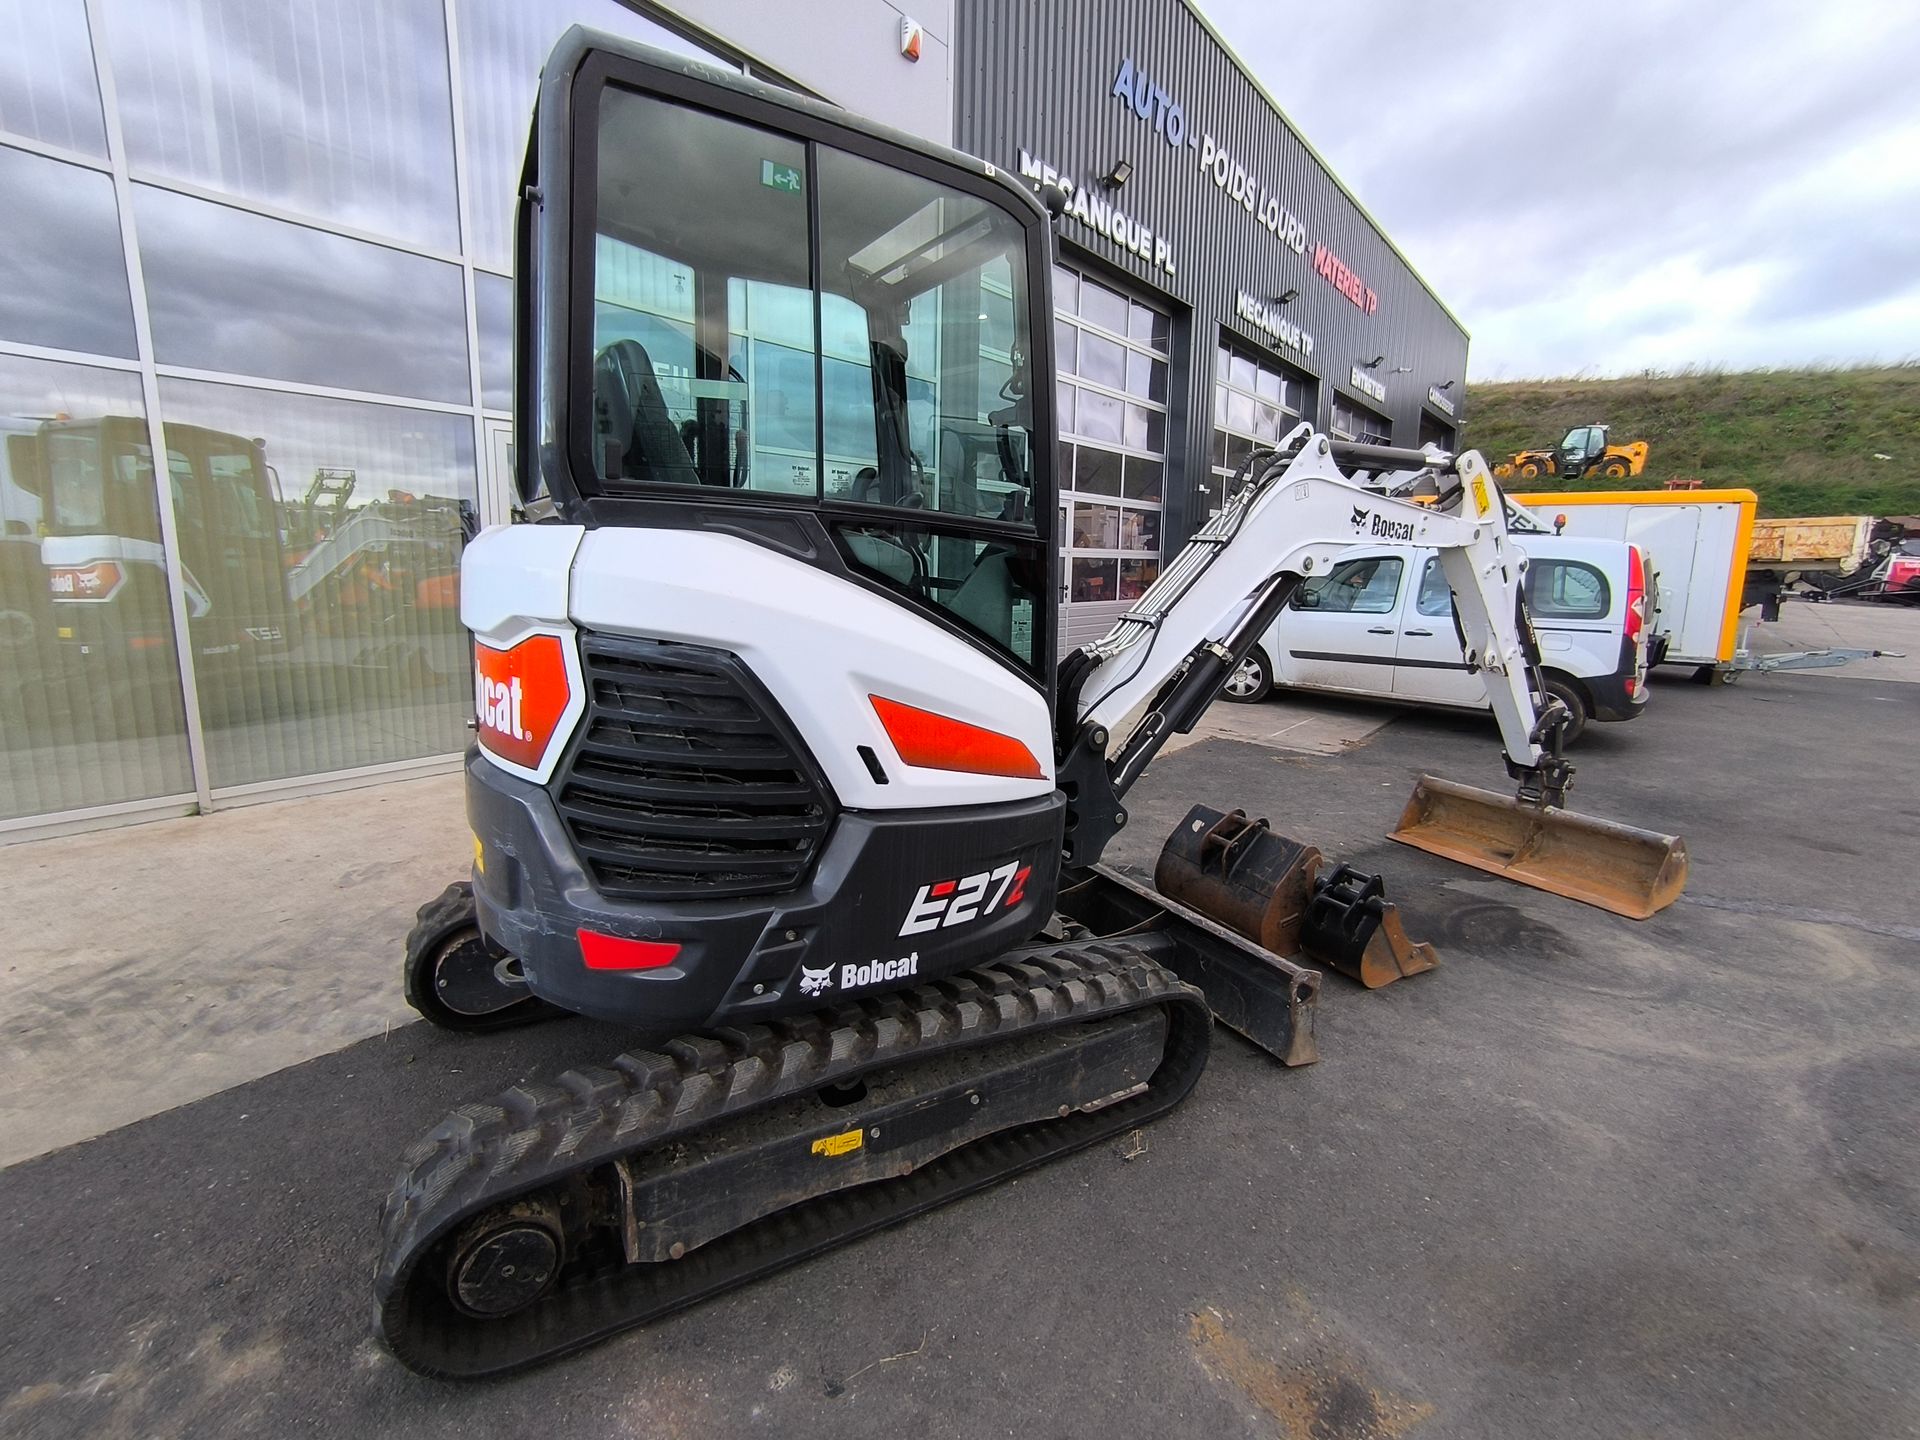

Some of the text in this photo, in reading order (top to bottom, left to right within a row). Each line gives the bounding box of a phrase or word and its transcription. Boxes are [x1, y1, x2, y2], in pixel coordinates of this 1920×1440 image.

[1112, 57, 1185, 147] AUTO
[1200, 133, 1256, 213] POIDS
[1256, 187, 1306, 255] LOURD
[1313, 240, 1362, 308] MATERIEL
[1363, 286, 1377, 316] TP
[1155, 236, 1176, 276] PL
[1236, 290, 1314, 357] MECANIQUE TP
[1371, 513, 1415, 541] Bobcat
[841, 952, 919, 990] Bobcat
